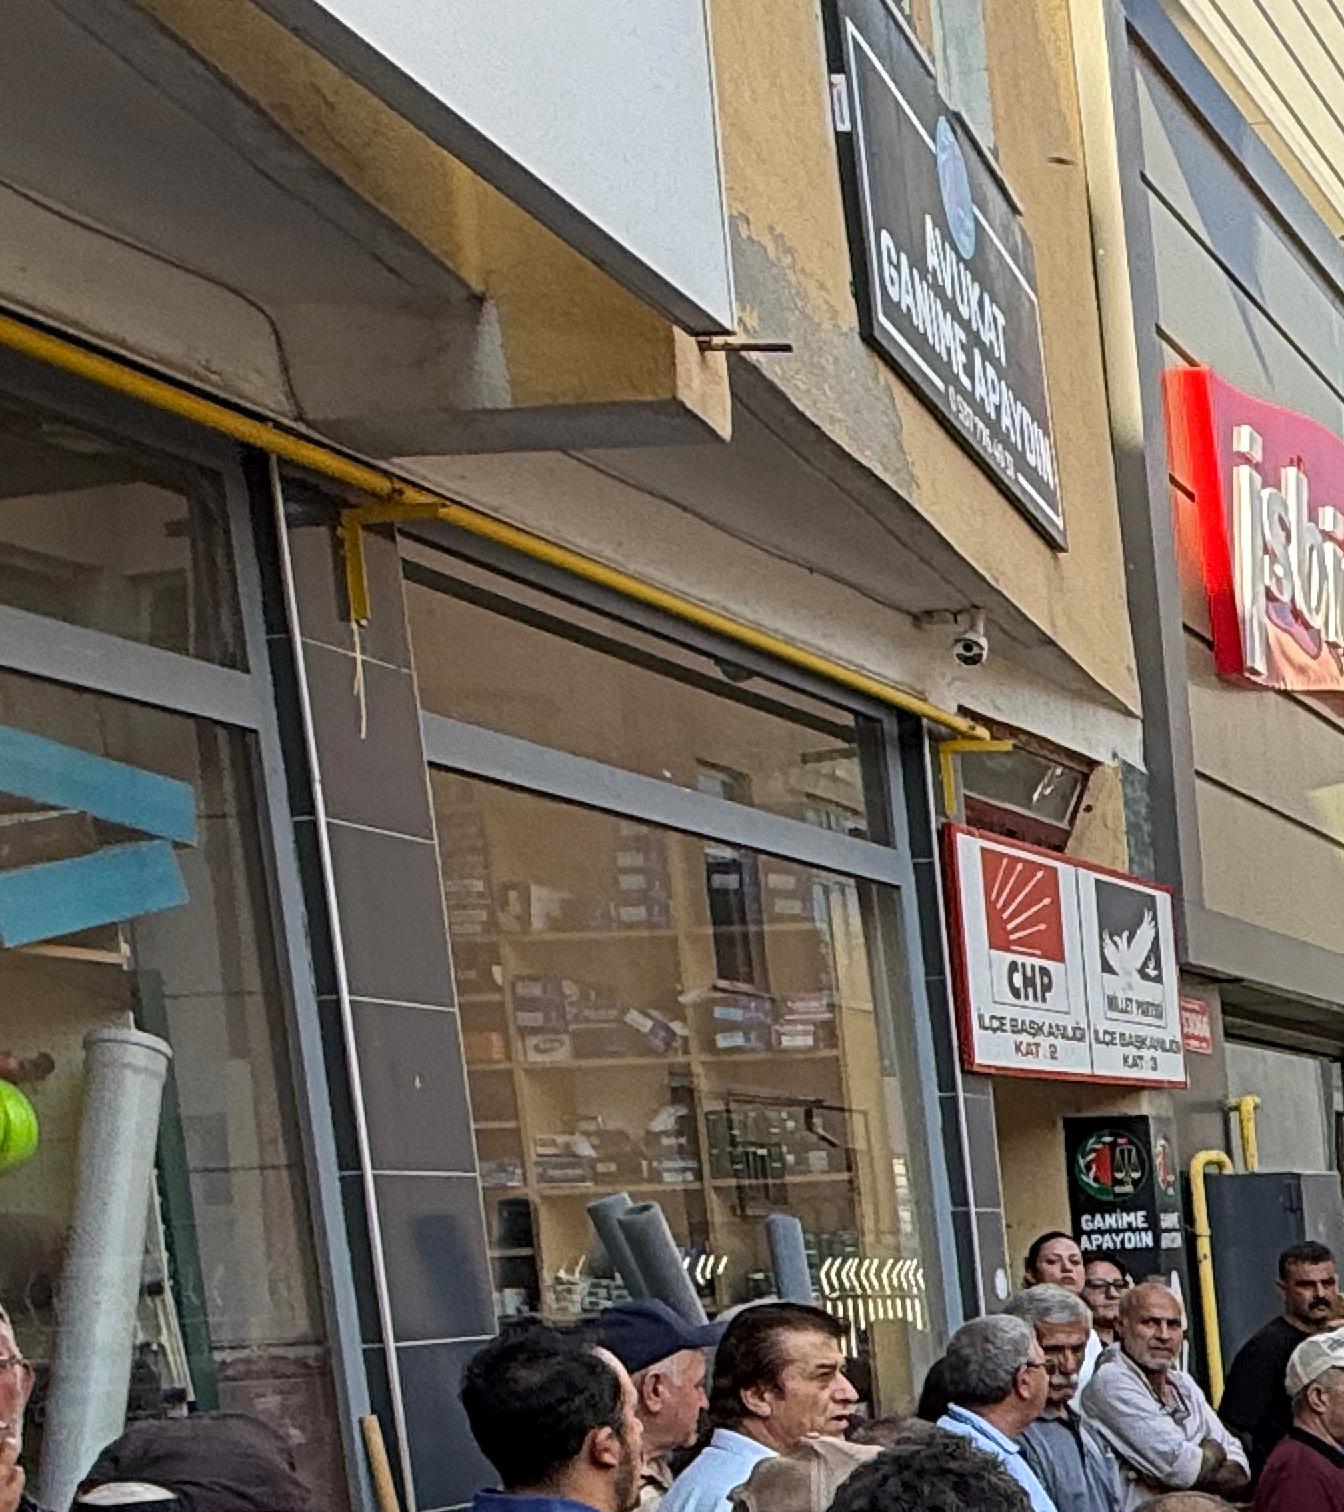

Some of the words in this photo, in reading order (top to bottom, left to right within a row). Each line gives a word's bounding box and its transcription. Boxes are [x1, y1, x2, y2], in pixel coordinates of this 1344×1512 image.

[924, 214, 1007, 368] AVUKAT
[880, 229, 972, 392] GANİME
[974, 348, 1054, 490] APAYDIN
[1007, 960, 1053, 1004] CHP
[977, 1005, 1008, 1034] İLÇE
[1093, 1024, 1118, 1047] İLÇE
[1014, 1041, 1041, 1059] KAT
[1048, 1043, 1058, 1060] 2
[1122, 1053, 1144, 1069] KAT
[1150, 1055, 1158, 1072] 3
[1081, 1207, 1149, 1232] GANİME
[1080, 1231, 1154, 1251] APAYDIN
